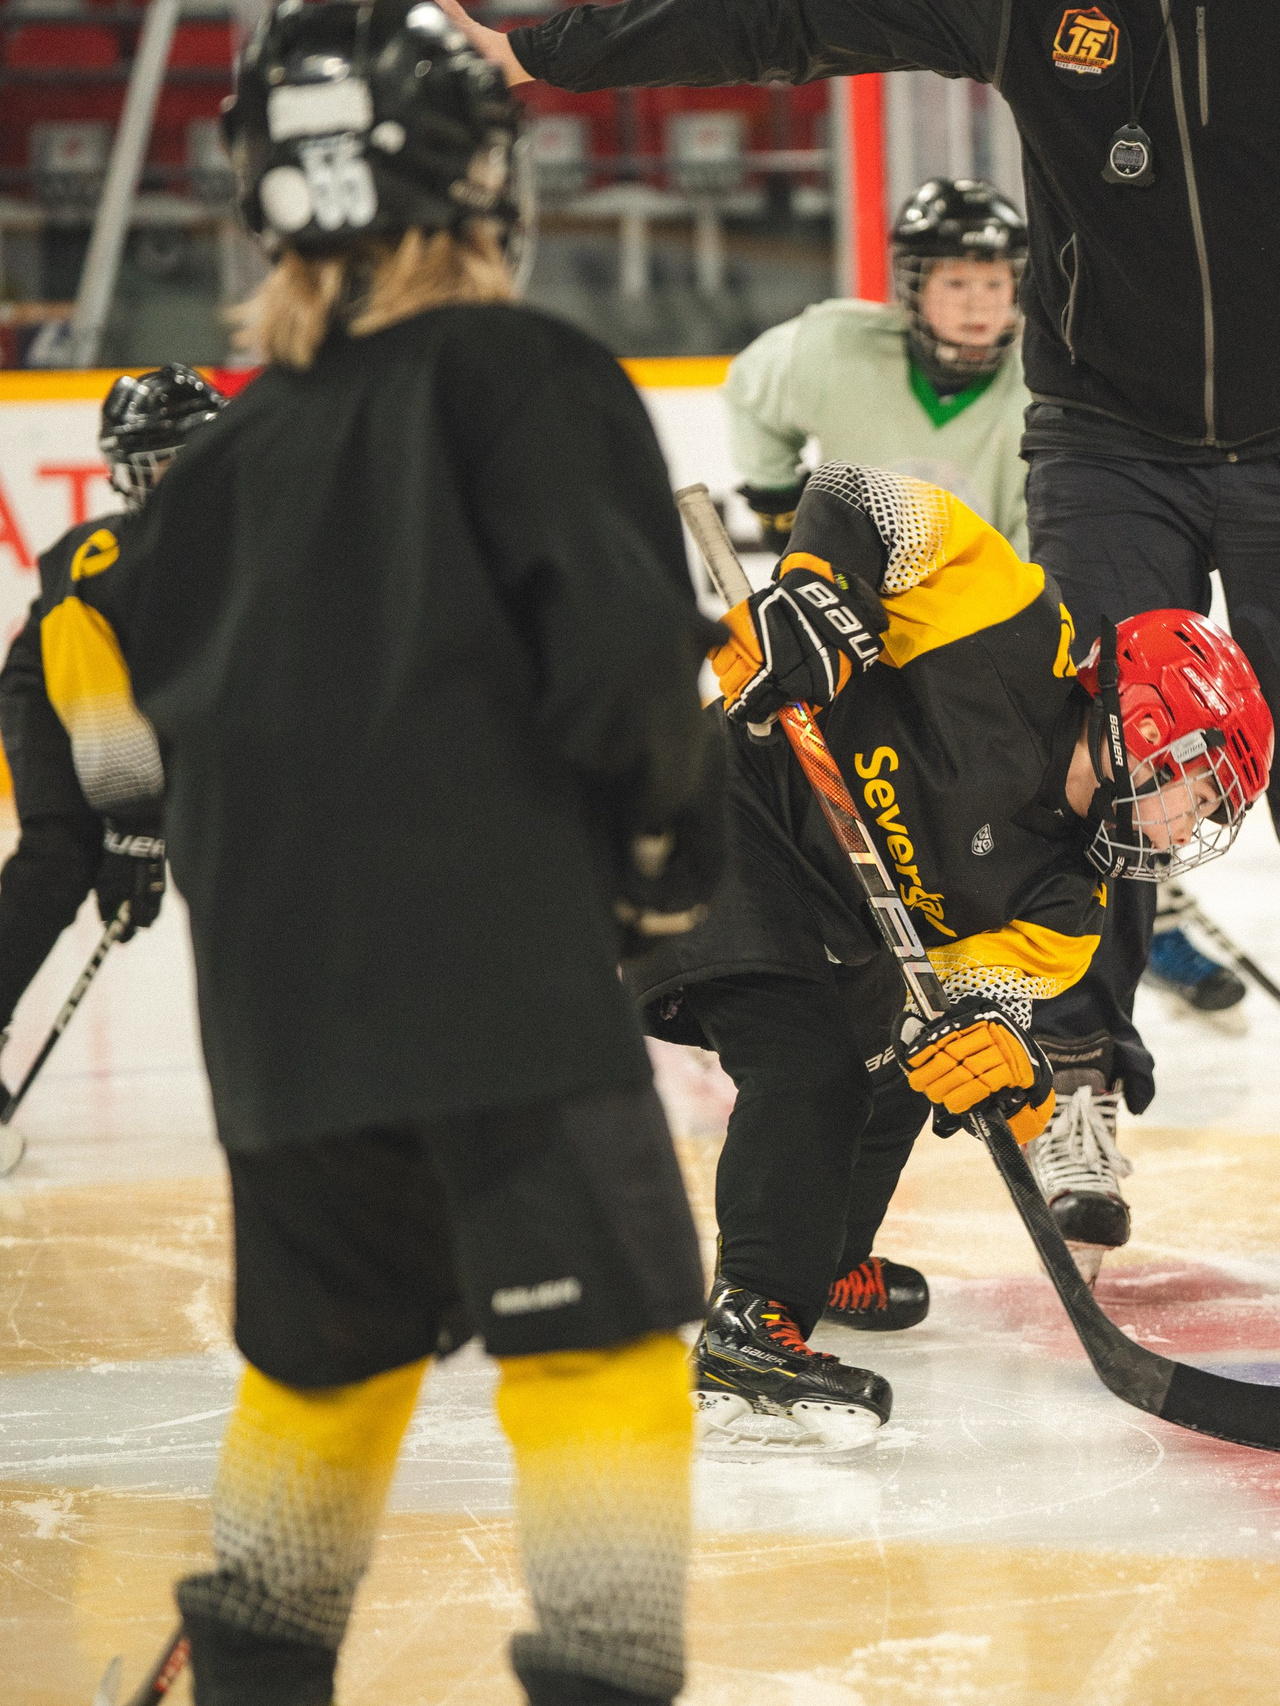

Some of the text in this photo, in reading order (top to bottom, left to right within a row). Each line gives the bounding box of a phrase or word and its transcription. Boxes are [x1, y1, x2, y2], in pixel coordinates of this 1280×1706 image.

[1067, 25, 1108, 59] 15
[1183, 666, 1228, 717] BAUER
[1109, 713, 1124, 767] BAUER
[739, 1345, 788, 1366] BAUER
